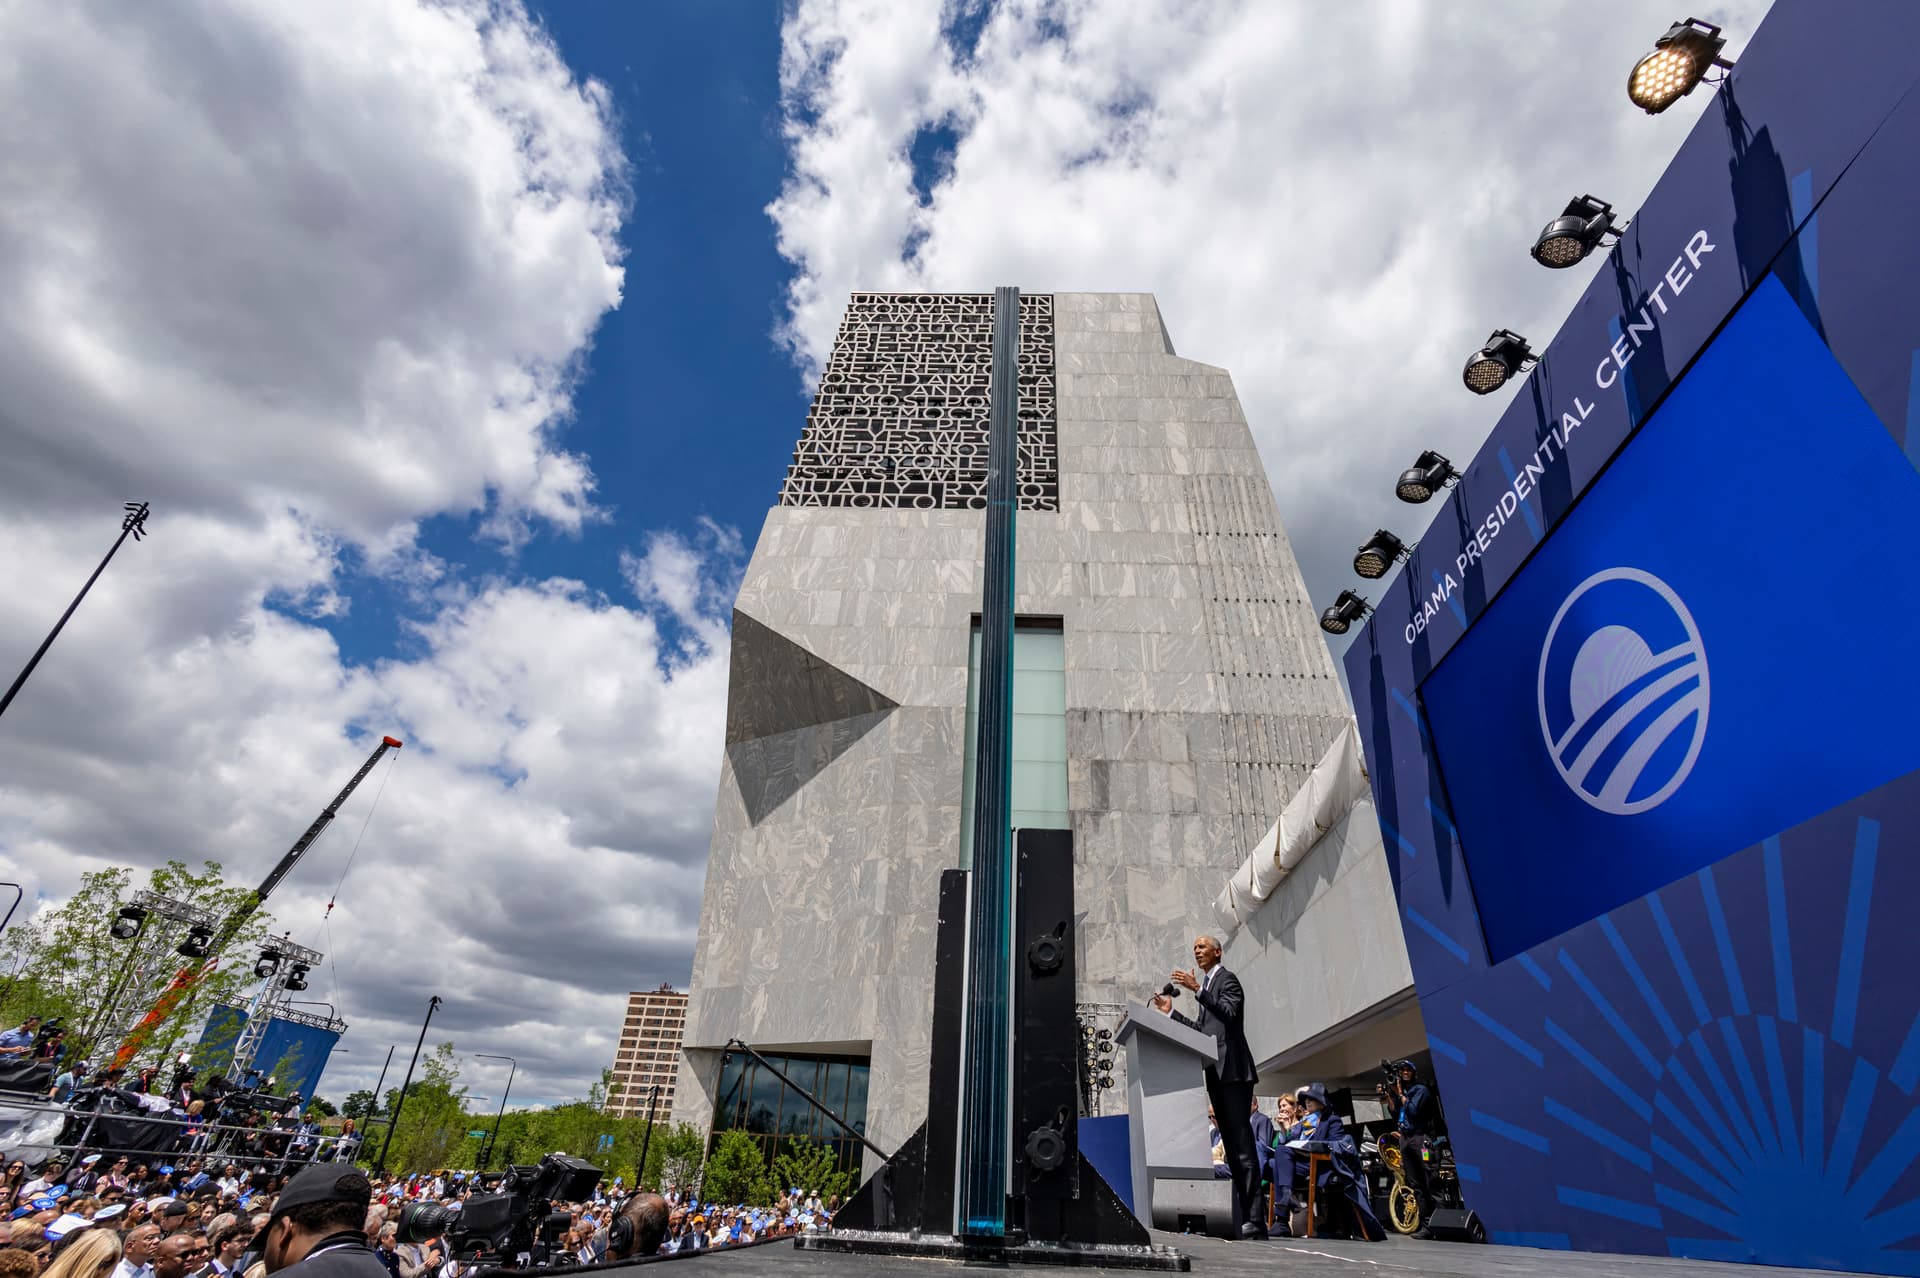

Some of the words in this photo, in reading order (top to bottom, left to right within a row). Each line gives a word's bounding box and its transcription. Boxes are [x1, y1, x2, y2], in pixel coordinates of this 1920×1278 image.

[853, 294, 1052, 306] UNCONSTIN
[853, 304, 1052, 315] CONVENTON
[846, 313, 878, 323] BY
[902, 323, 995, 334] OUGH
[980, 334, 1046, 345] TIS
[833, 342, 889, 353] ARE
[897, 342, 970, 354] FIRST
[976, 343, 1053, 355] SPS
[832, 352, 867, 363] RE
[873, 352, 896, 363] IS
[904, 352, 968, 364] NEW
[974, 353, 1053, 365] GOU
[829, 362, 865, 374] RE
[880, 363, 939, 374] ARE
[824, 373, 920, 384] OSSED
[928, 374, 1054, 387] AMECA
[863, 384, 903, 395] OF
[911, 385, 971, 396] ANY
[853, 395, 934, 407] MOST
[945, 396, 1053, 409] POER
[816, 405, 835, 417] R
[851, 406, 1053, 420] DEMOCRCY
[813, 417, 858, 429] WE
[861, 417, 923, 430] THE
[936, 419, 1053, 432] PEOLE
[866, 429, 920, 442] YES
[928, 431, 976, 443] WE
[1405, 573, 1457, 644] OBAMA
[1456, 397, 1595, 577] PRESIDENTIAL
[1596, 229, 1717, 389] CENTER
[885, 442, 926, 455] BY
[933, 443, 978, 456] NO
[798, 454, 985, 469] EVERYONE
[827, 467, 913, 481] TASK
[919, 468, 971, 482] WE
[983, 470, 1047, 483] RE
[784, 480, 912, 494] NUALLY
[923, 481, 988, 495] TRY
[780, 493, 899, 508] NATION
[912, 495, 958, 509] OF
[966, 496, 1058, 512] ORS
